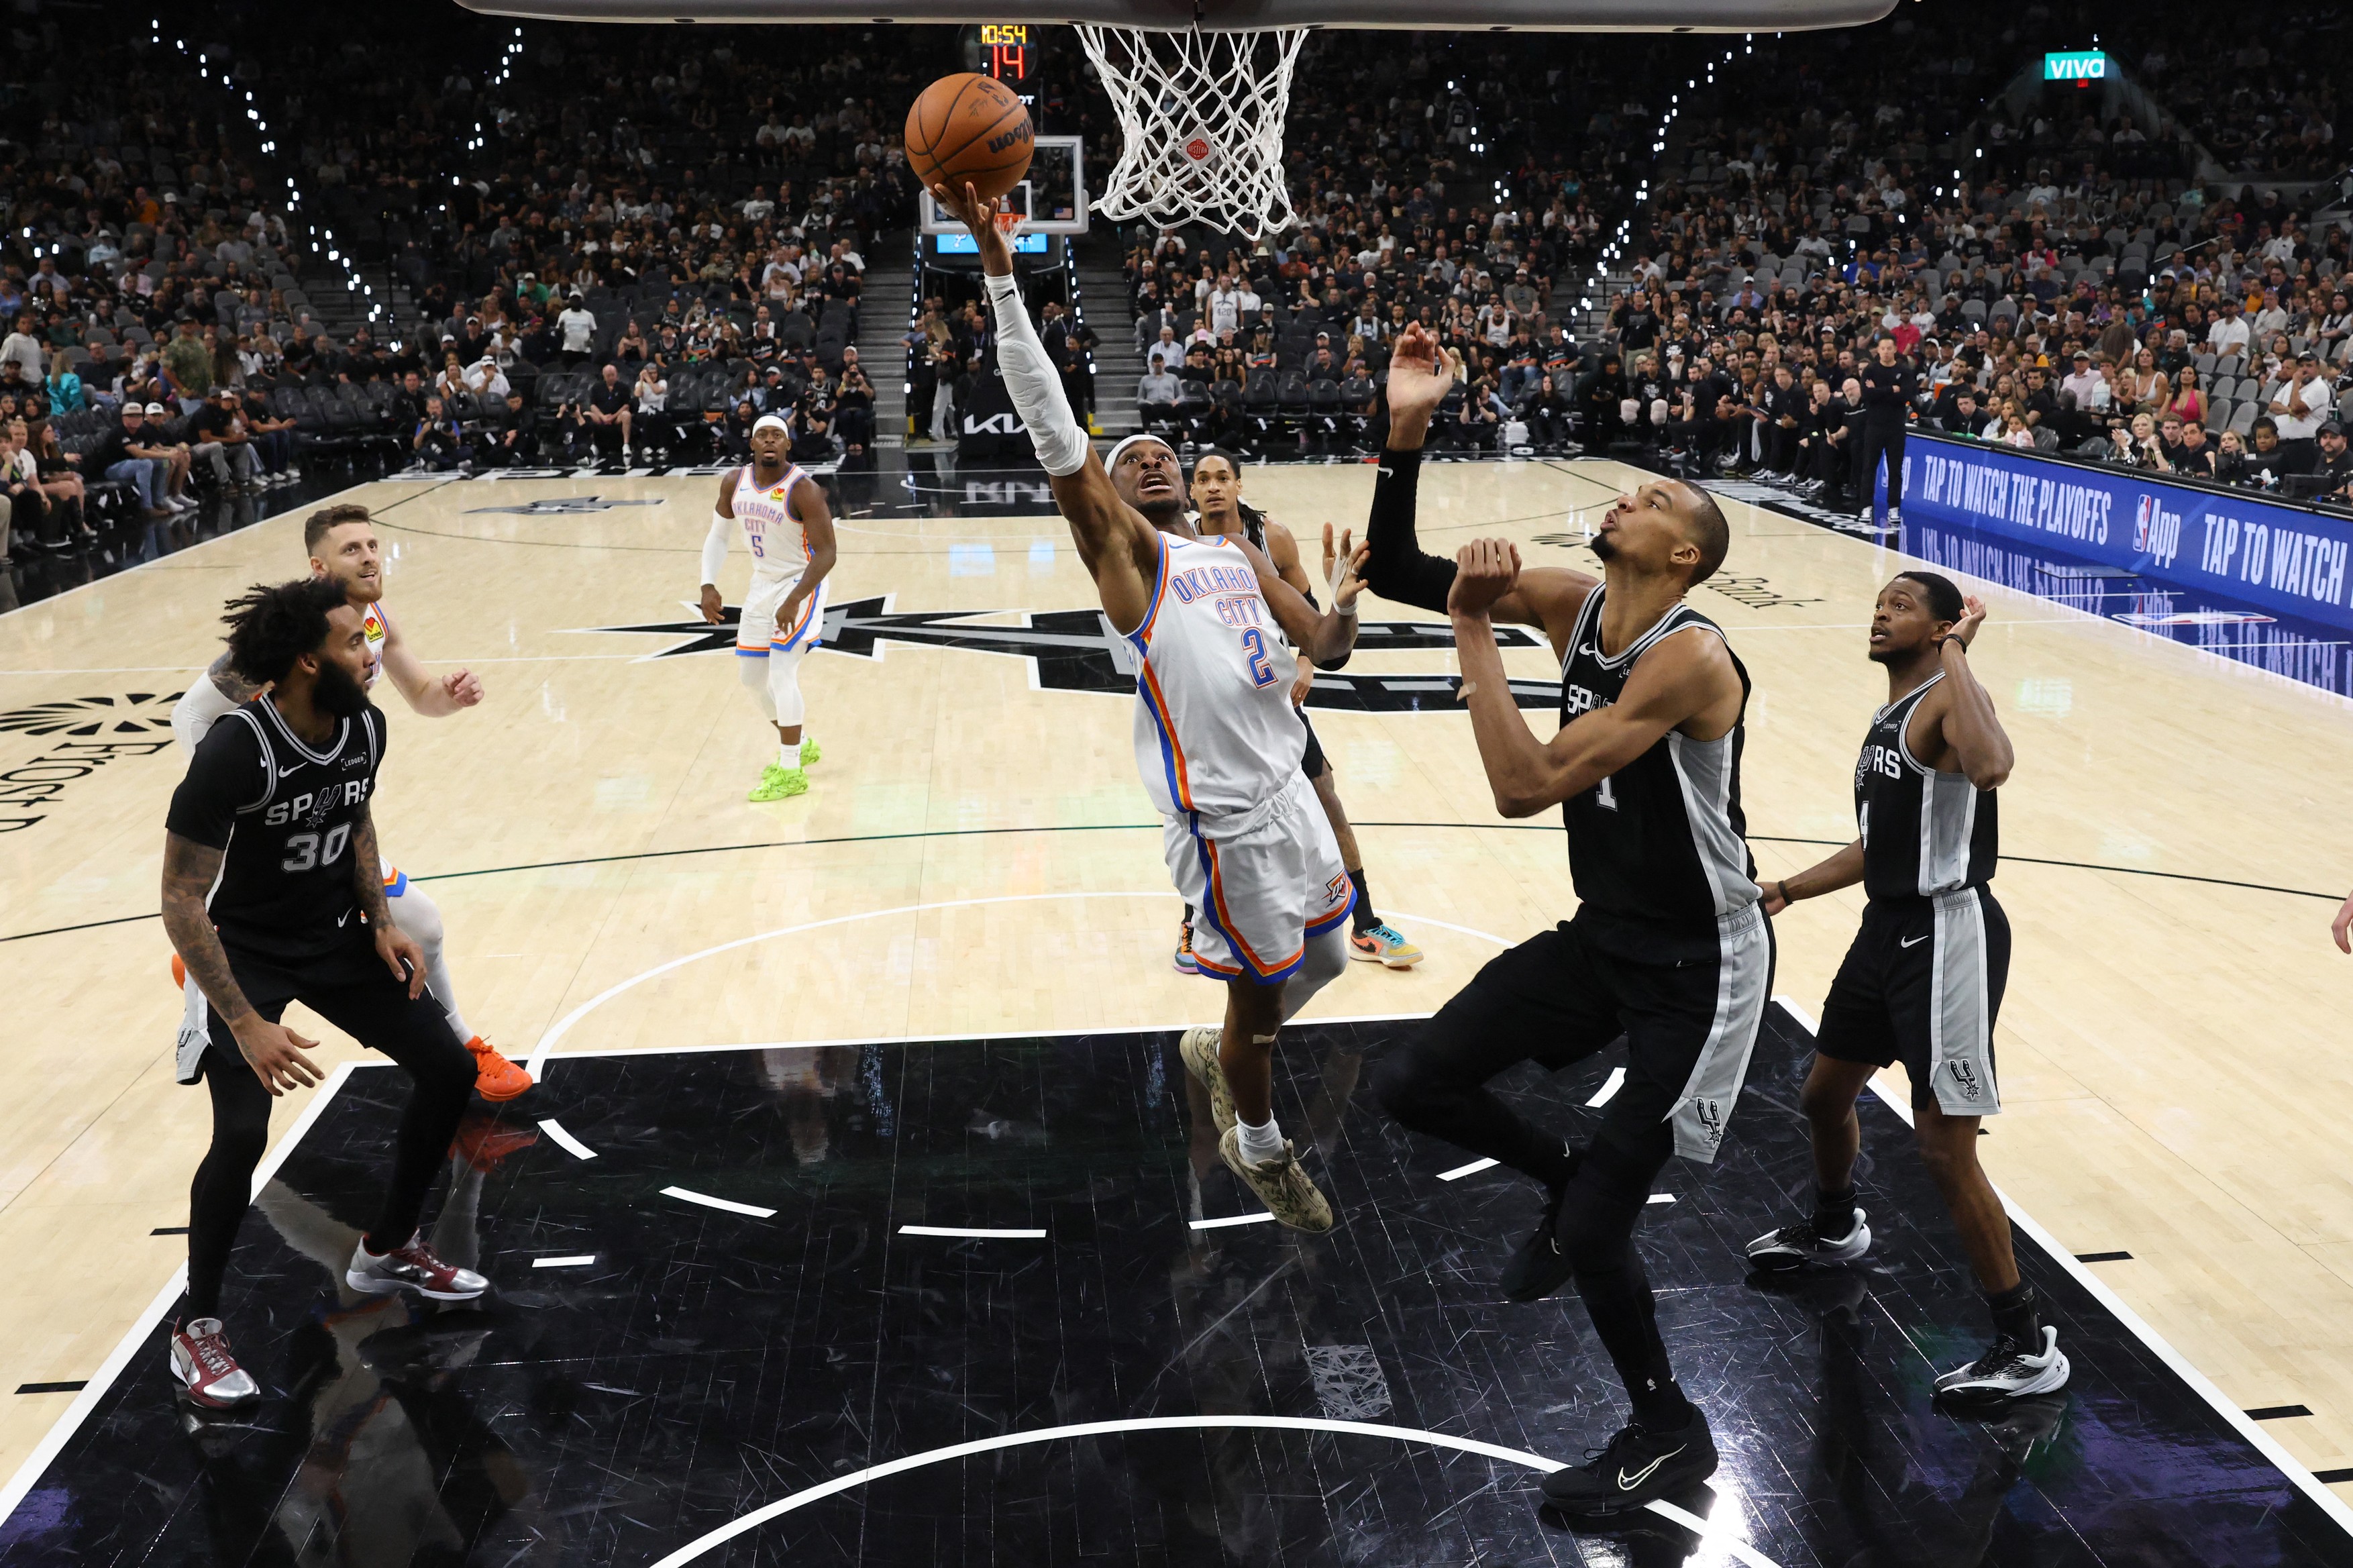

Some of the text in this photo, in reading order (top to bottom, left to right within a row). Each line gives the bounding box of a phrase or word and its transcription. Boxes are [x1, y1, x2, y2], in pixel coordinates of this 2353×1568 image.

[982, 25, 1027, 44] 10:54
[992, 45, 1025, 80] 14
[2050, 58, 2105, 79] viva
[1923, 454, 1946, 503] TAP
[1946, 459, 1964, 508] TO
[1963, 463, 2010, 519] WATCH
[2009, 472, 2038, 527] THE
[2036, 478, 2112, 546] PLAYOFFS
[745, 519, 767, 533] CITY
[2146, 498, 2181, 569] App
[751, 535, 765, 558] 5
[2201, 513, 2240, 576] TAP
[2240, 521, 2269, 585] TO
[2270, 527, 2348, 605] WATCH
[1169, 566, 1261, 604] OKLAHO
[1215, 595, 1263, 627] CITY
[1241, 626, 1279, 690] 2
[345, 756, 364, 767] LEDGER
[264, 777, 369, 827] SPURS
[280, 821, 353, 873] 30
